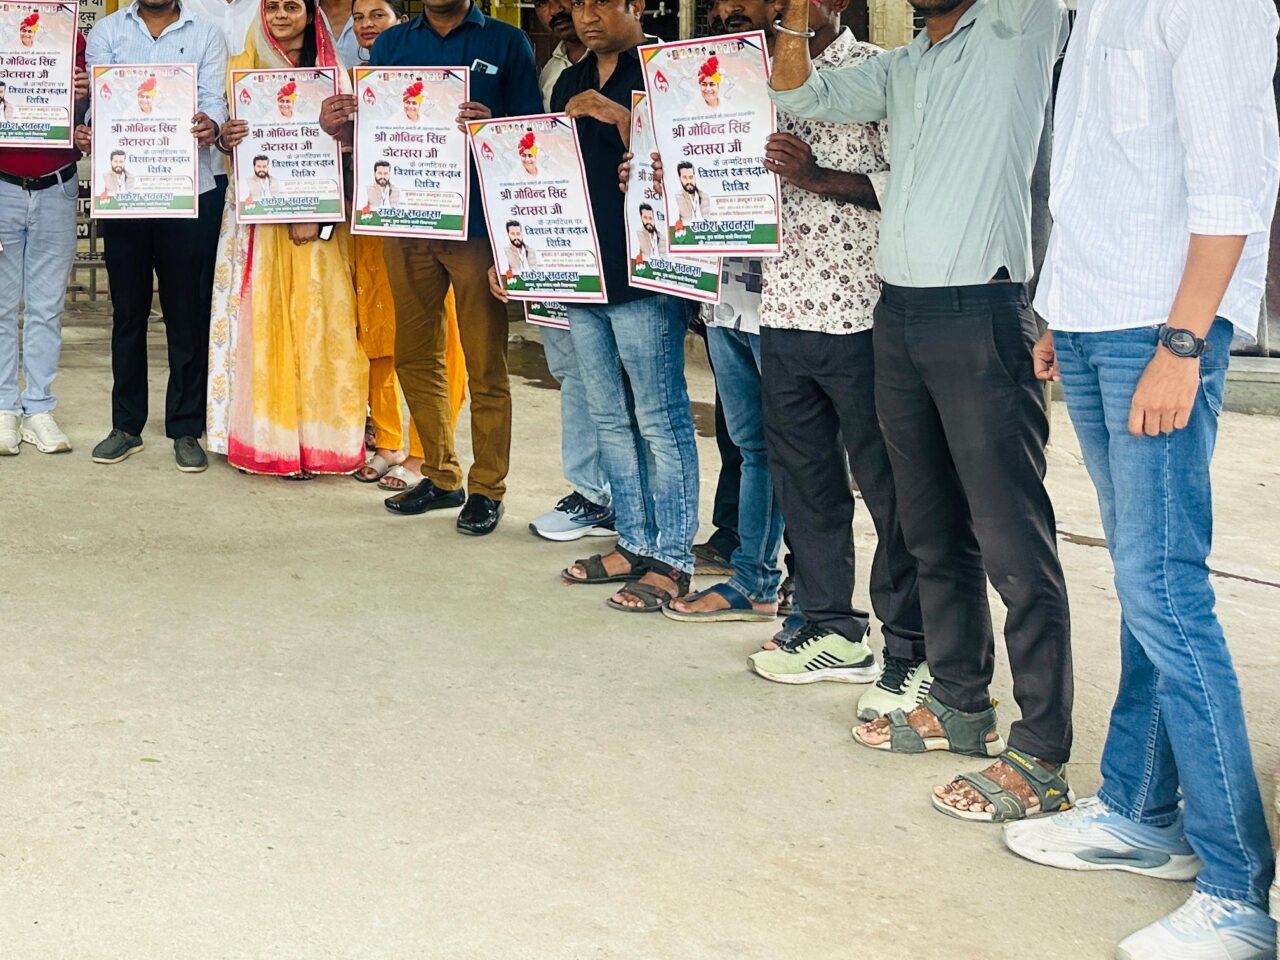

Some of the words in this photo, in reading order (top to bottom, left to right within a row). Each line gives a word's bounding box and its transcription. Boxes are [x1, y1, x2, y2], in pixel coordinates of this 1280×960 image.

[672, 125, 685, 138] श्री
[688, 122, 725, 137] गोविन्द
[729, 119, 751, 134] सिंह
[683, 143, 725, 156] डोटासरा
[727, 140, 742, 153] जी
[500, 189, 512, 201] श्री
[550, 203, 563, 215] जी
